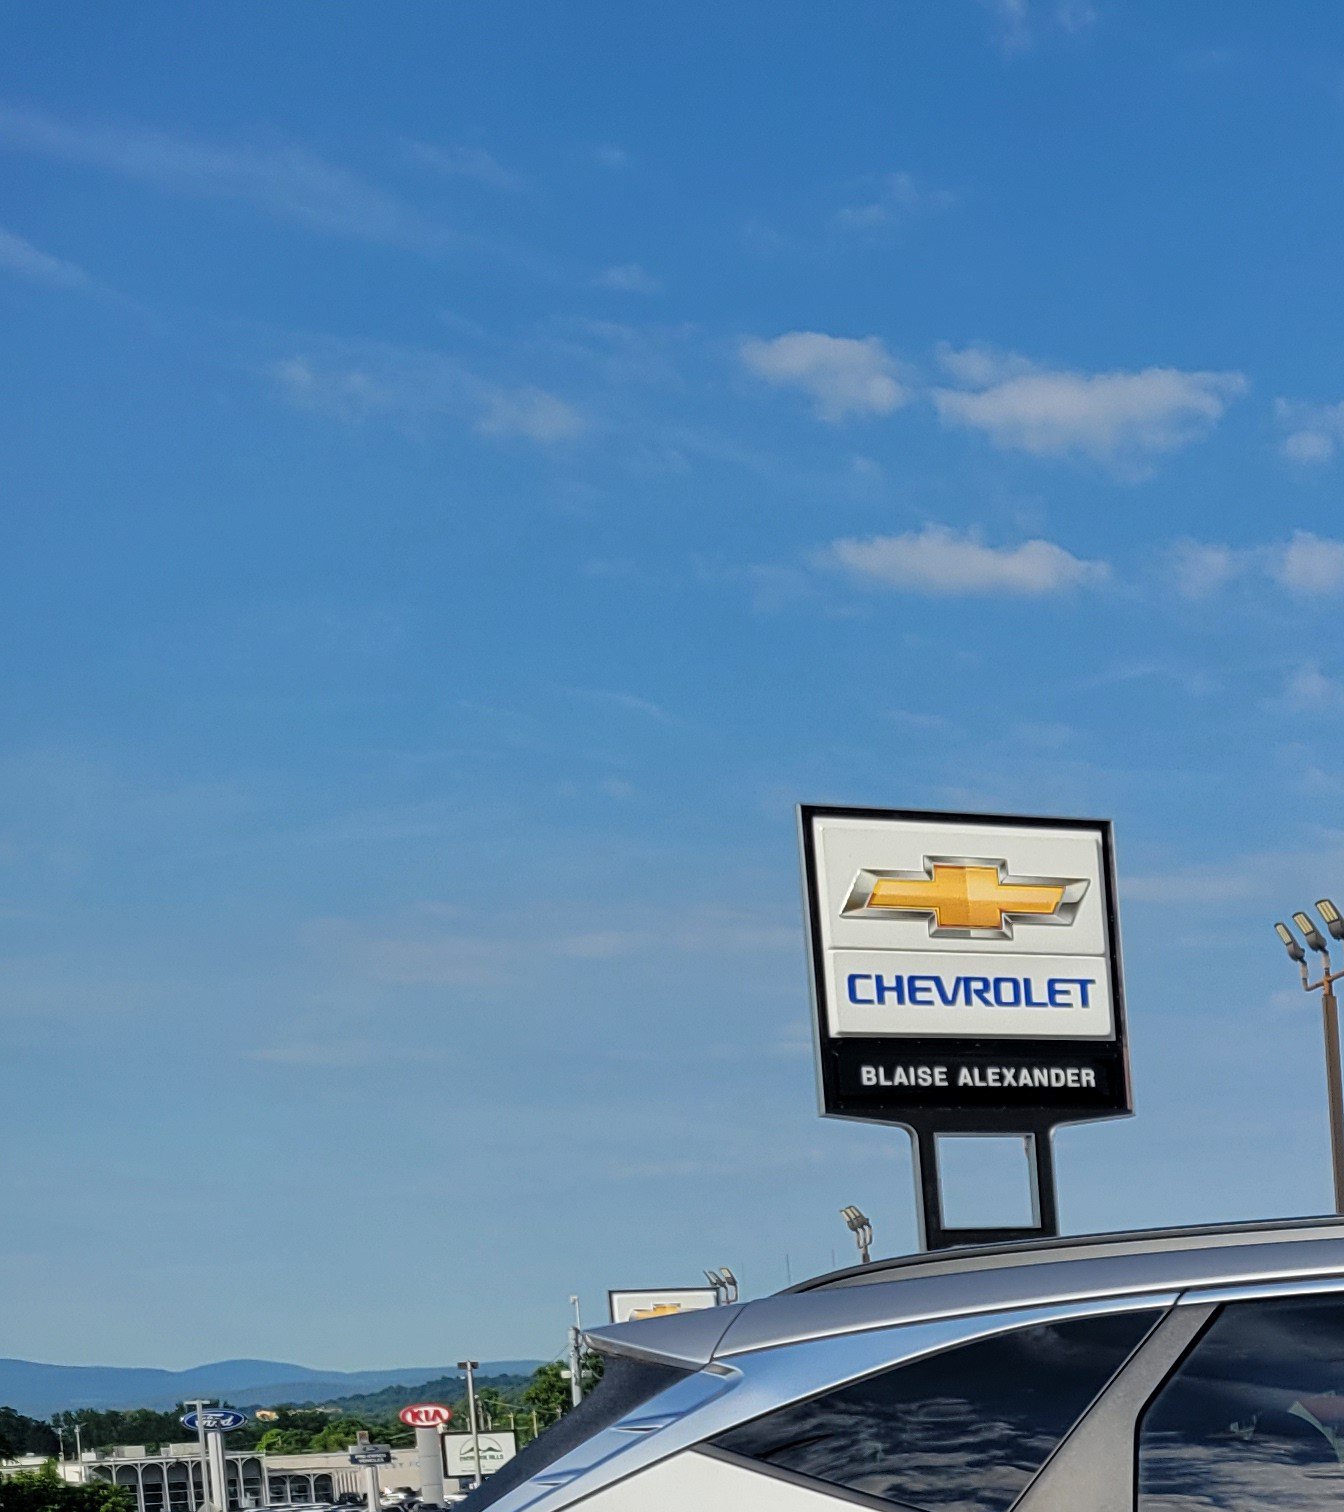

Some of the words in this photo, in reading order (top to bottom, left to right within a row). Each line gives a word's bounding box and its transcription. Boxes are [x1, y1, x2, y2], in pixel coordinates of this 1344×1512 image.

[846, 973, 1096, 1009] CHEVROLET
[861, 1065, 948, 1087] BLAISE
[957, 1066, 1097, 1088] ALEXANDER
[411, 1409, 444, 1423] KIA
